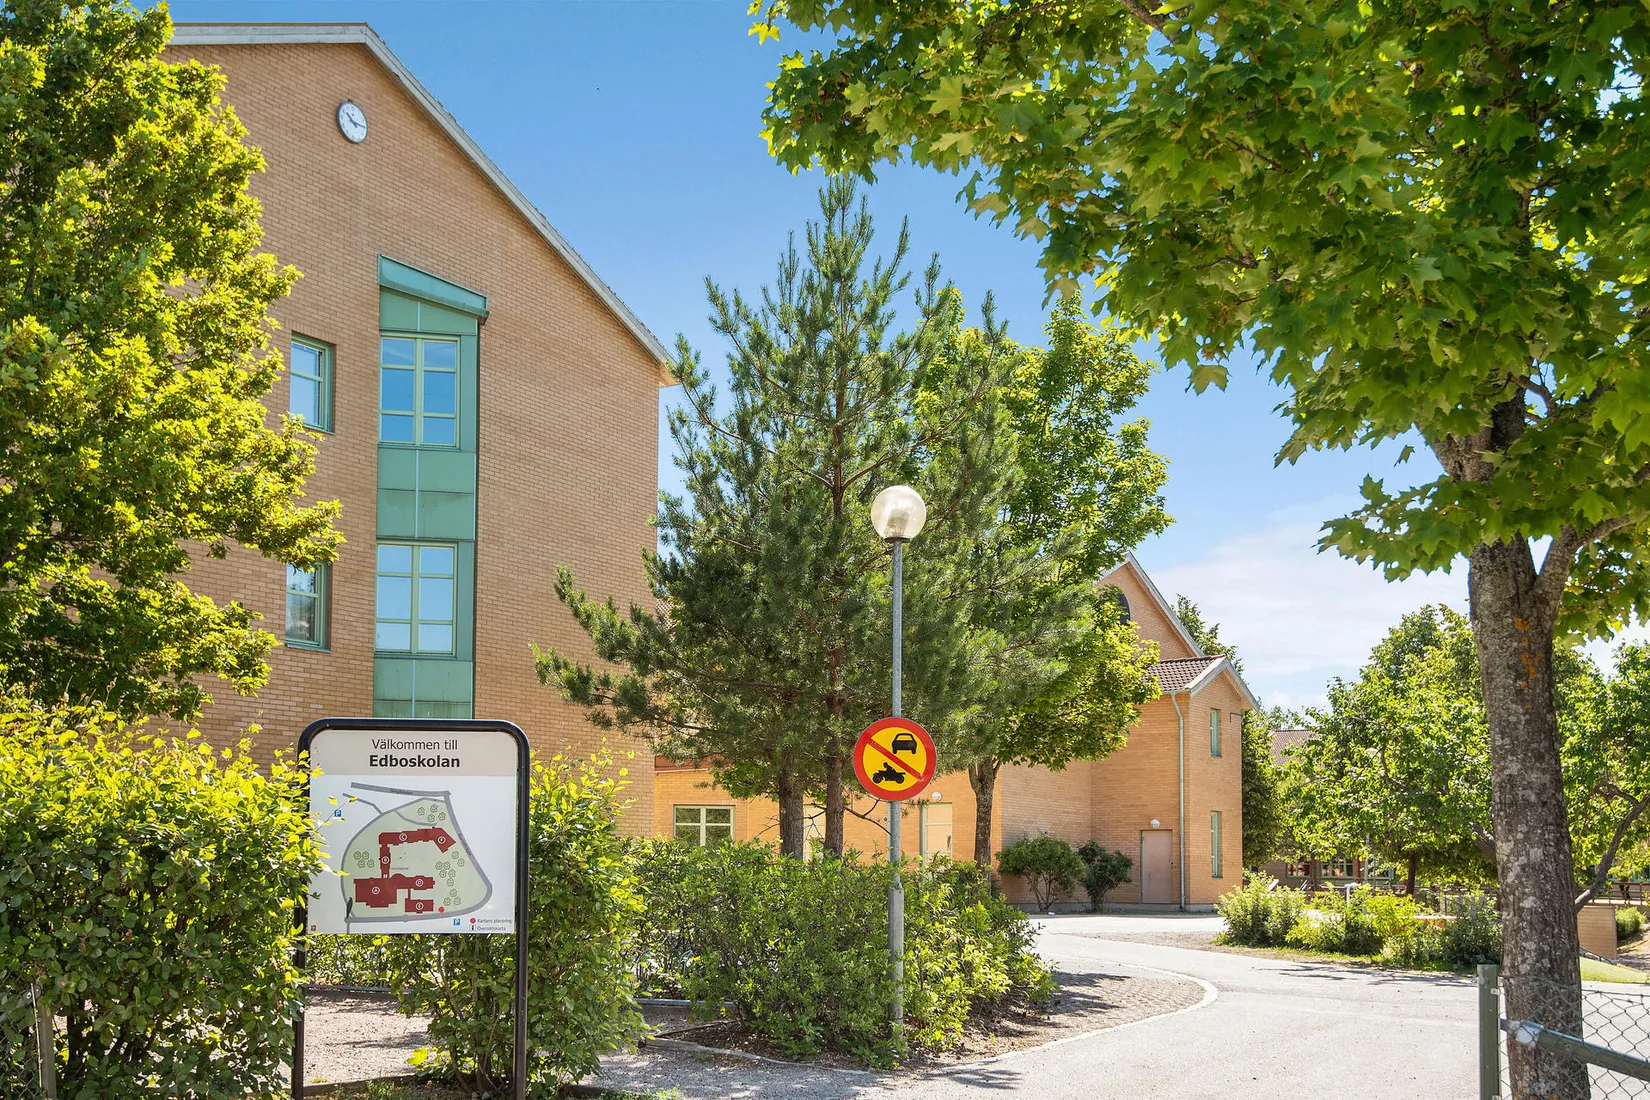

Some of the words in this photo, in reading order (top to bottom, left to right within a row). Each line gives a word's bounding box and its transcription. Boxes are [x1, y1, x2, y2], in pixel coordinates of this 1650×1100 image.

[371, 739, 440, 750] Välkommen
[444, 739, 458, 750] till
[369, 754, 461, 768] Edboskolan
